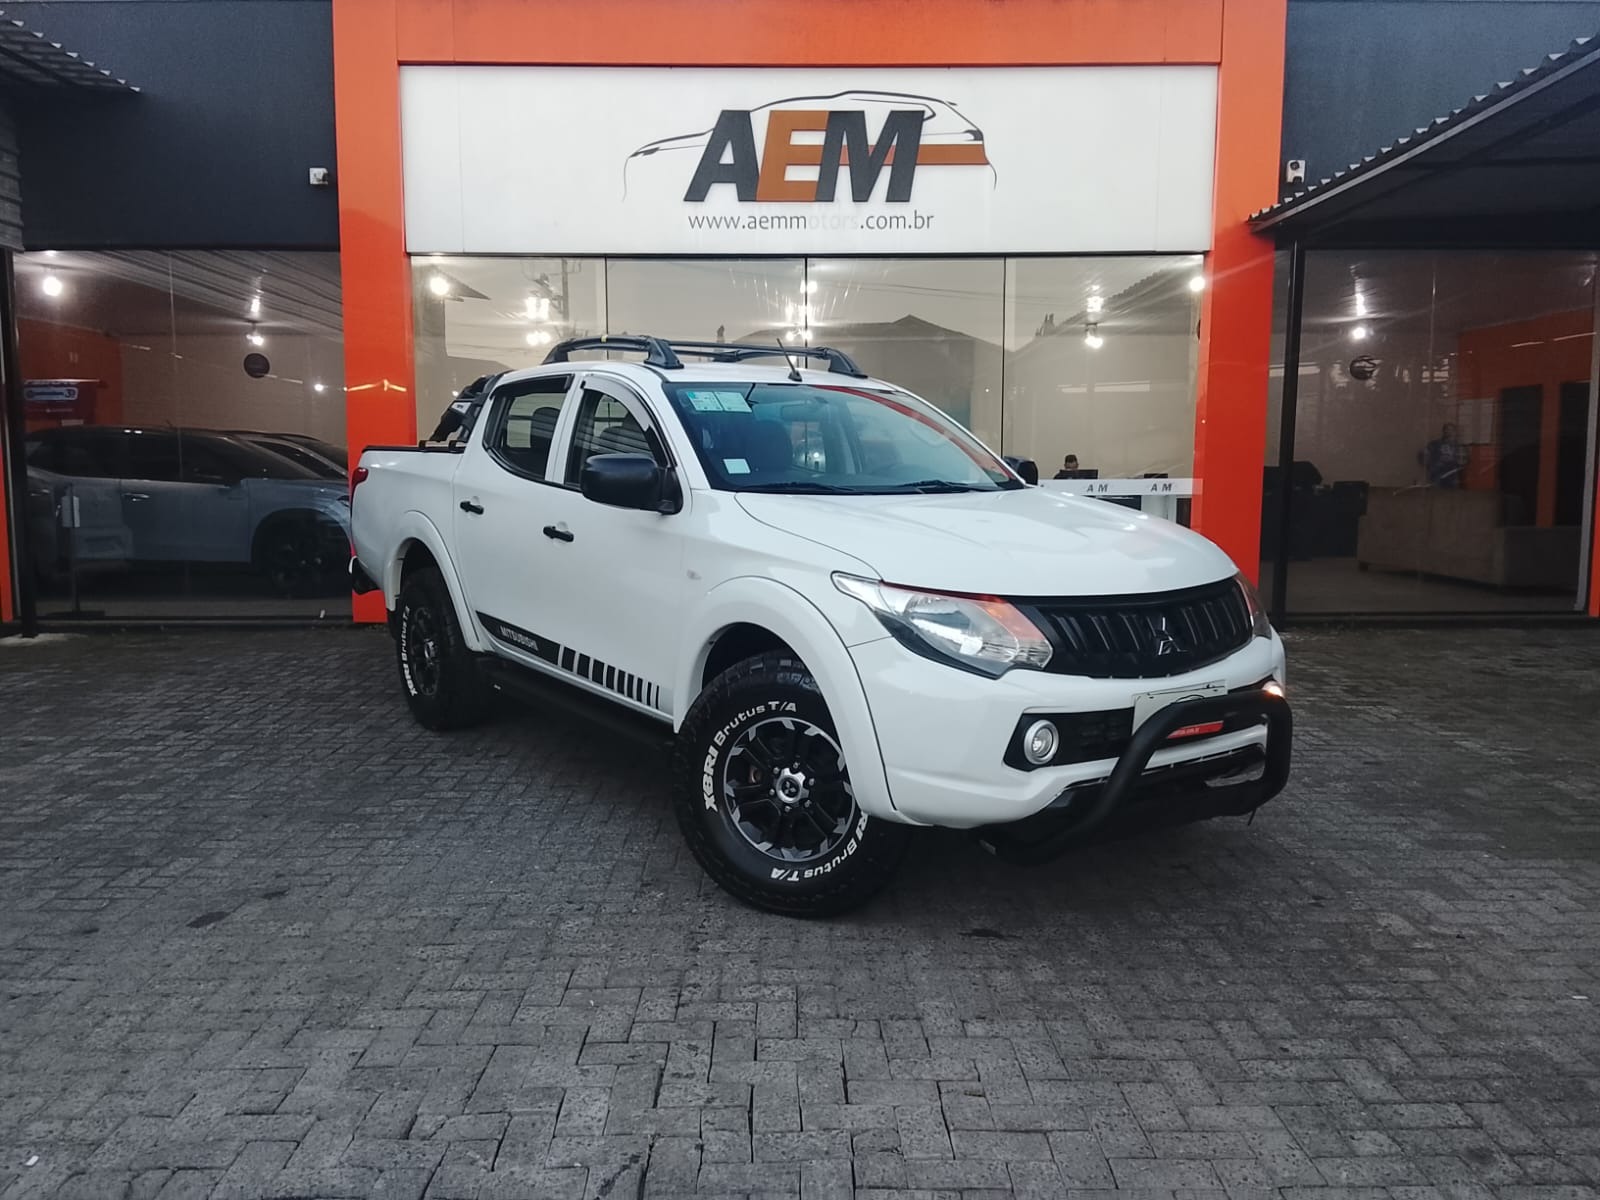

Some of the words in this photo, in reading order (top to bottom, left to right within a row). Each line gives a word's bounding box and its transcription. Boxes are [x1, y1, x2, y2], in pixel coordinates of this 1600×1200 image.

[684, 110, 925, 203] AEM
[702, 745, 719, 812] XBRI
[713, 704, 766, 747] Brutus
[768, 700, 798, 713] T/A
[770, 867, 800, 881] T/A
[804, 839, 859, 878] Brutus
